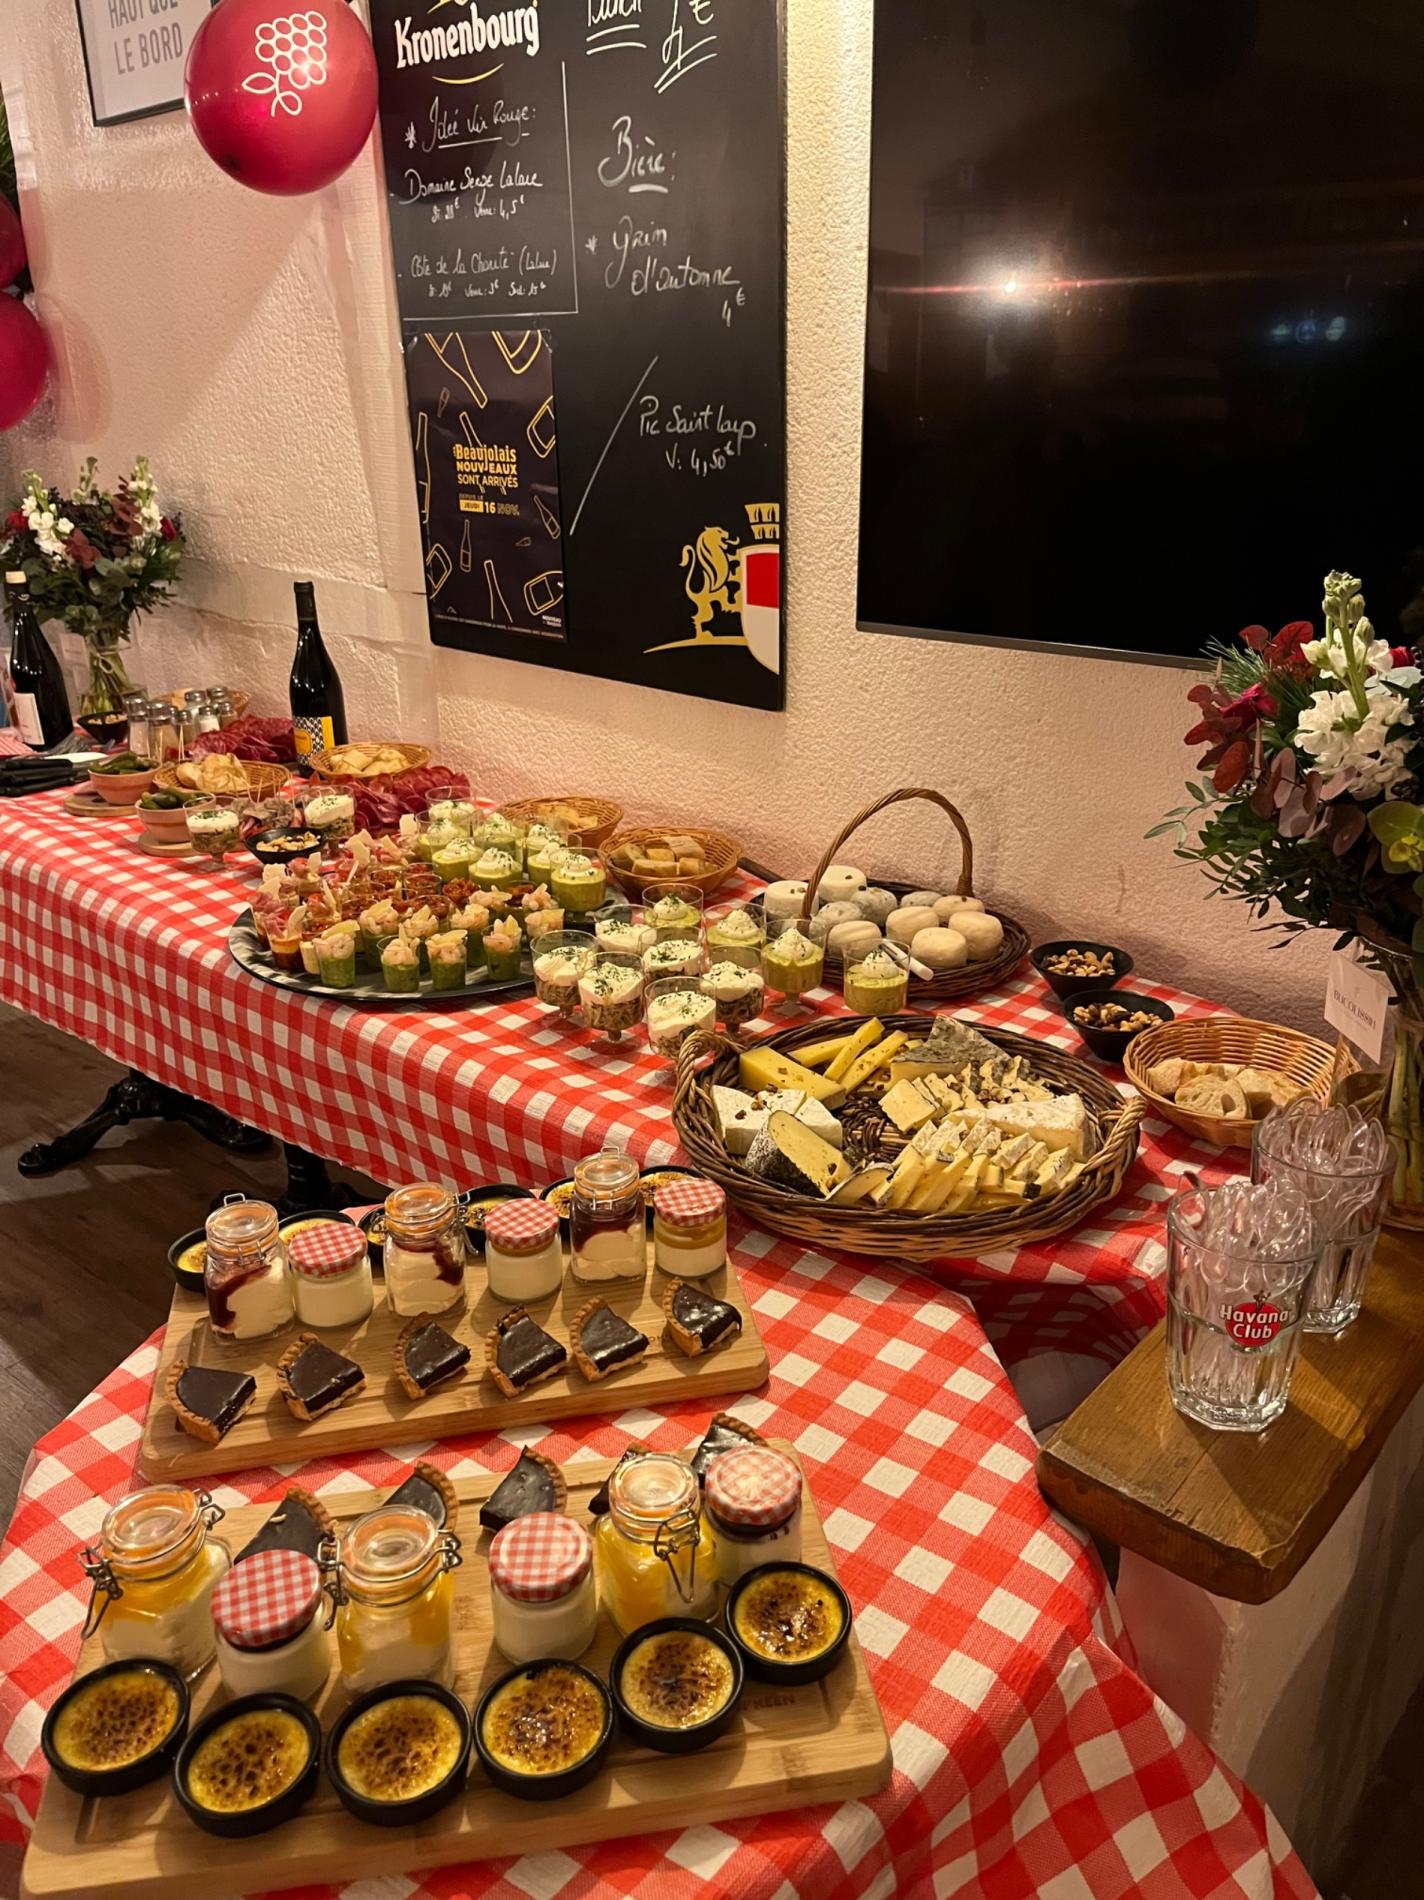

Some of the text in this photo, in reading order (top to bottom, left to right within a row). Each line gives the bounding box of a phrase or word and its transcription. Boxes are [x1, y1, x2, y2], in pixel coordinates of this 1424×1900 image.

[394, 2, 540, 69] Kronenbourg
[114, 22, 183, 75] LE BORD
[400, 169, 456, 205] Domaine
[666, 404, 713, 434] Saint
[455, 443, 517, 471] Beaujolais
[456, 461, 518, 475] NOUVEAUX
[458, 474, 519, 489] SONT ARRIVÉS
[485, 501, 496, 514] 16
[1220, 1304, 1289, 1324] Havana
[1232, 1323, 1272, 1339] Club
